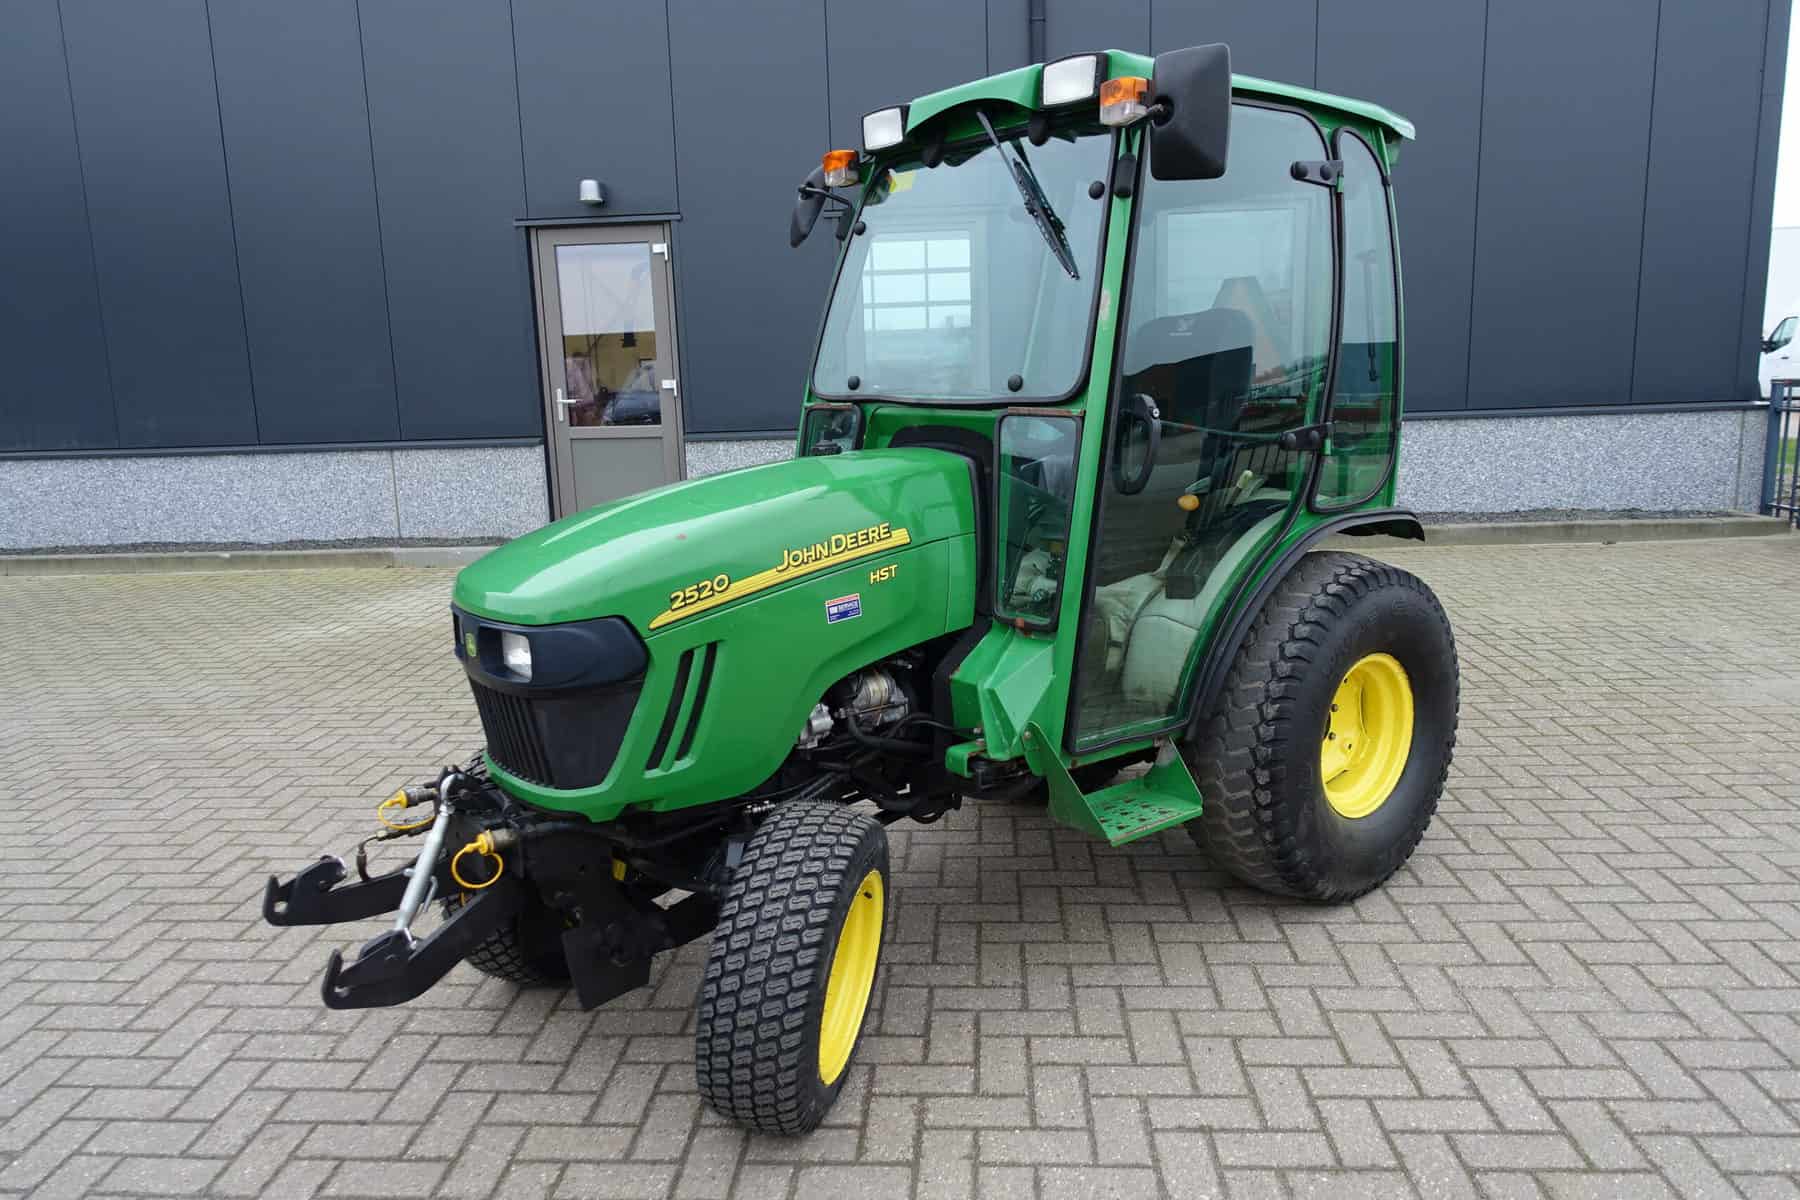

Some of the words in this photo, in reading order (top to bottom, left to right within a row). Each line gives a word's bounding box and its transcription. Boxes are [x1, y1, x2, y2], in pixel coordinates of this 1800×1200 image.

[776, 541, 829, 573] JOHN
[830, 523, 892, 555] DEERE
[671, 574, 730, 611] 2520
[869, 564, 898, 585] HST
